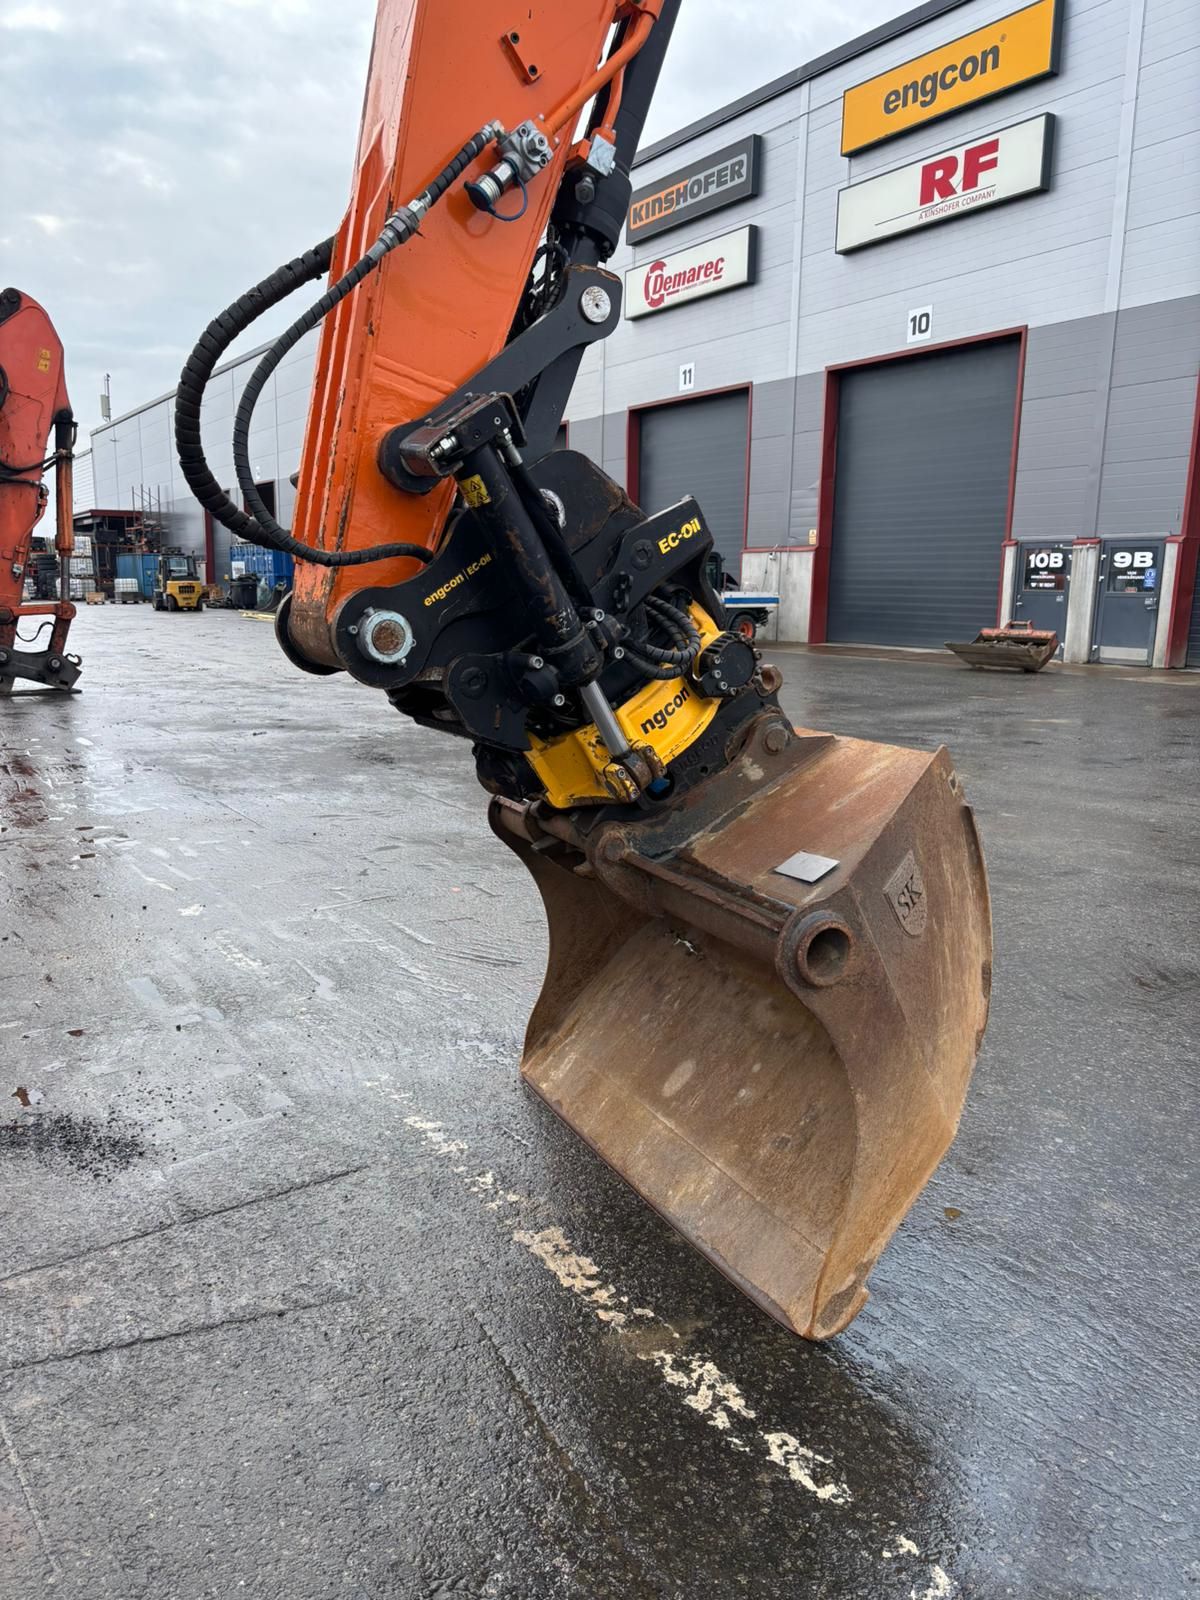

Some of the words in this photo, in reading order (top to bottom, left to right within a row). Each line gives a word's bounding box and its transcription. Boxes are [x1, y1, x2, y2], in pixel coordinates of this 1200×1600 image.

[883, 45, 1000, 115] engcon
[920, 138, 999, 207] RF
[632, 159, 745, 225] KINSHOFER
[924, 201, 960, 218] KINSHOFER
[961, 189, 996, 207] COMPANY
[652, 257, 725, 296] Demarec
[910, 312, 930, 336] 10
[682, 368, 692, 385] 11
[657, 517, 701, 555] EC-Oil
[1029, 552, 1063, 568] 10B
[1113, 551, 1153, 568] 9B
[424, 574, 464, 606] engcon
[467, 553, 492, 575] EC-Oil
